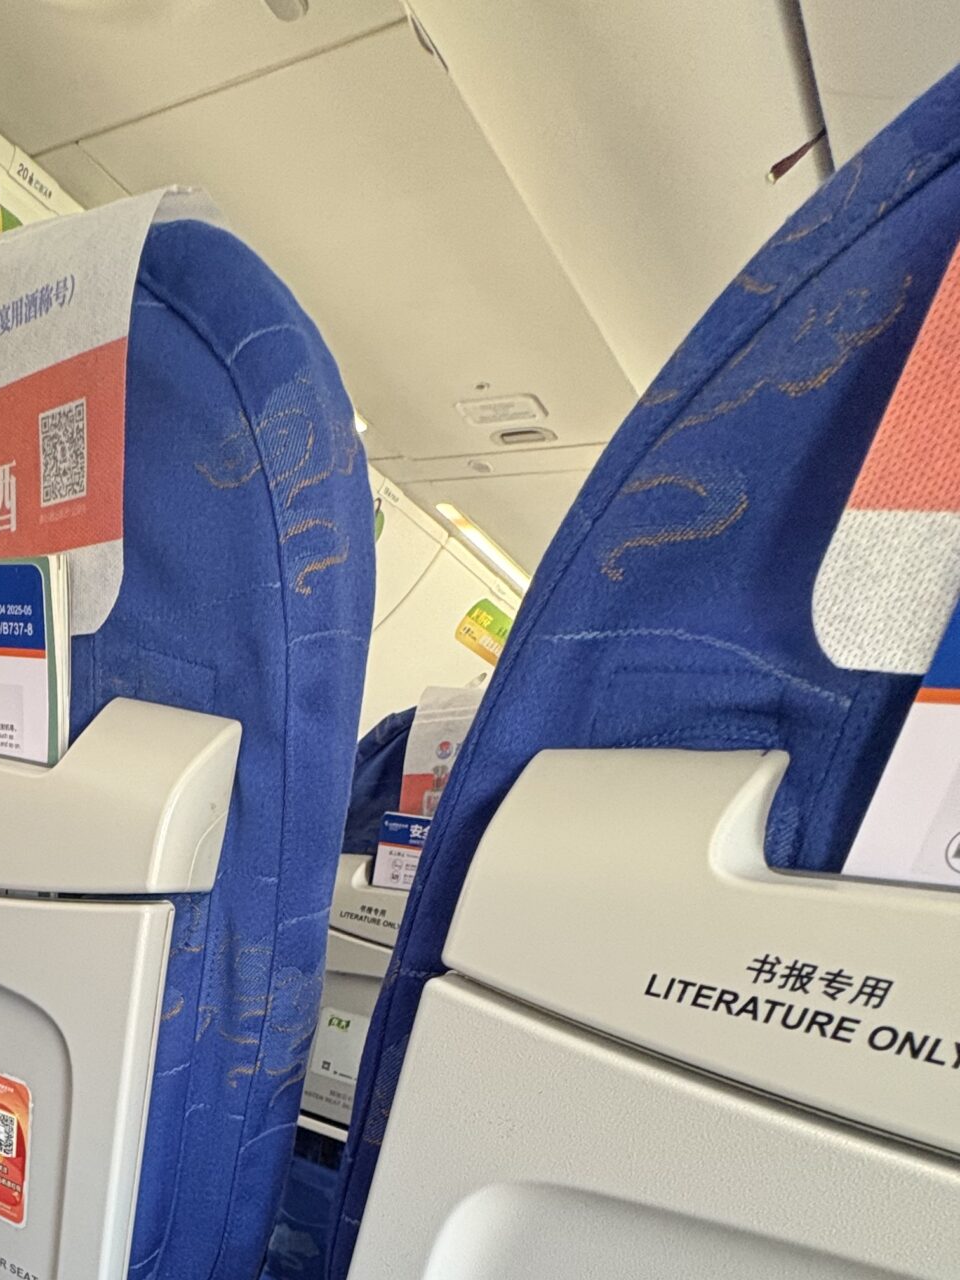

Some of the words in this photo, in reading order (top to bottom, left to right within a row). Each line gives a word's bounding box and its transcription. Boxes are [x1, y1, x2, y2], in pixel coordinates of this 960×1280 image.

[16, 163, 29, 180] 20
[340, 911, 381, 926] LITERATURE
[746, 953, 894, 1009] 书报专用
[643, 973, 861, 1043] LITERATURE
